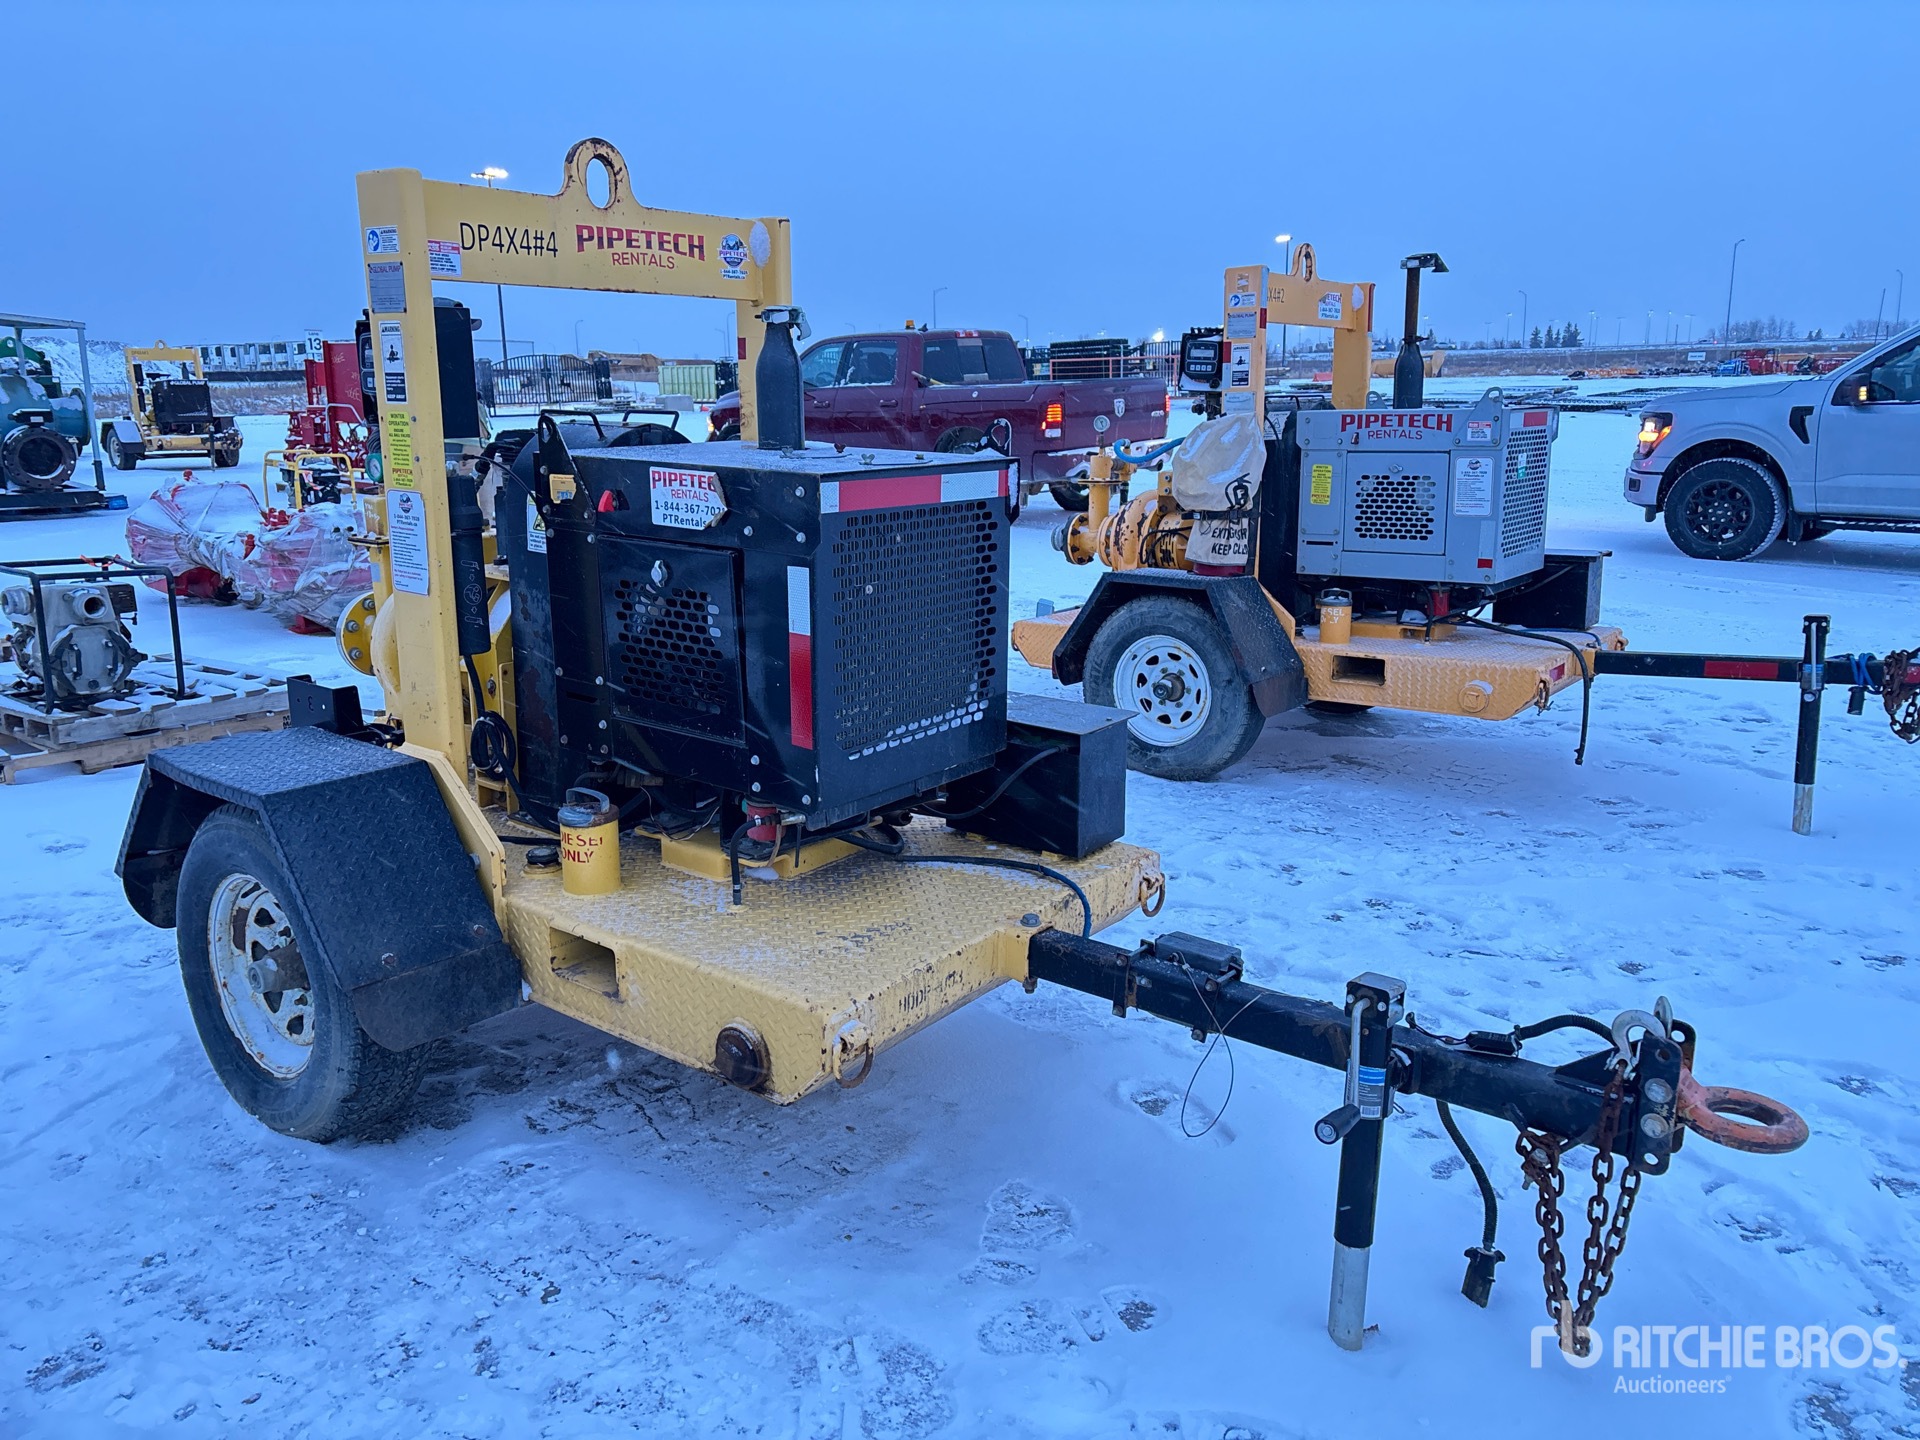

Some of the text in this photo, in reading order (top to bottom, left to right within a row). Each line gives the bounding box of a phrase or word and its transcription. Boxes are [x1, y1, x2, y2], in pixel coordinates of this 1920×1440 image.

[459, 222, 558, 258] DP4X4#4
[575, 224, 706, 261] PIPETECH
[611, 252, 676, 270] RENTALS
[1267, 287, 1285, 303] X4#2
[307, 338, 322, 351] 13
[1341, 413, 1453, 432] PIPETECH
[1367, 429, 1423, 440] RENTALS
[392, 468, 413, 476] PIPETECH
[671, 489, 709, 503] RENTALS
[1211, 542, 1232, 556] KEEP
